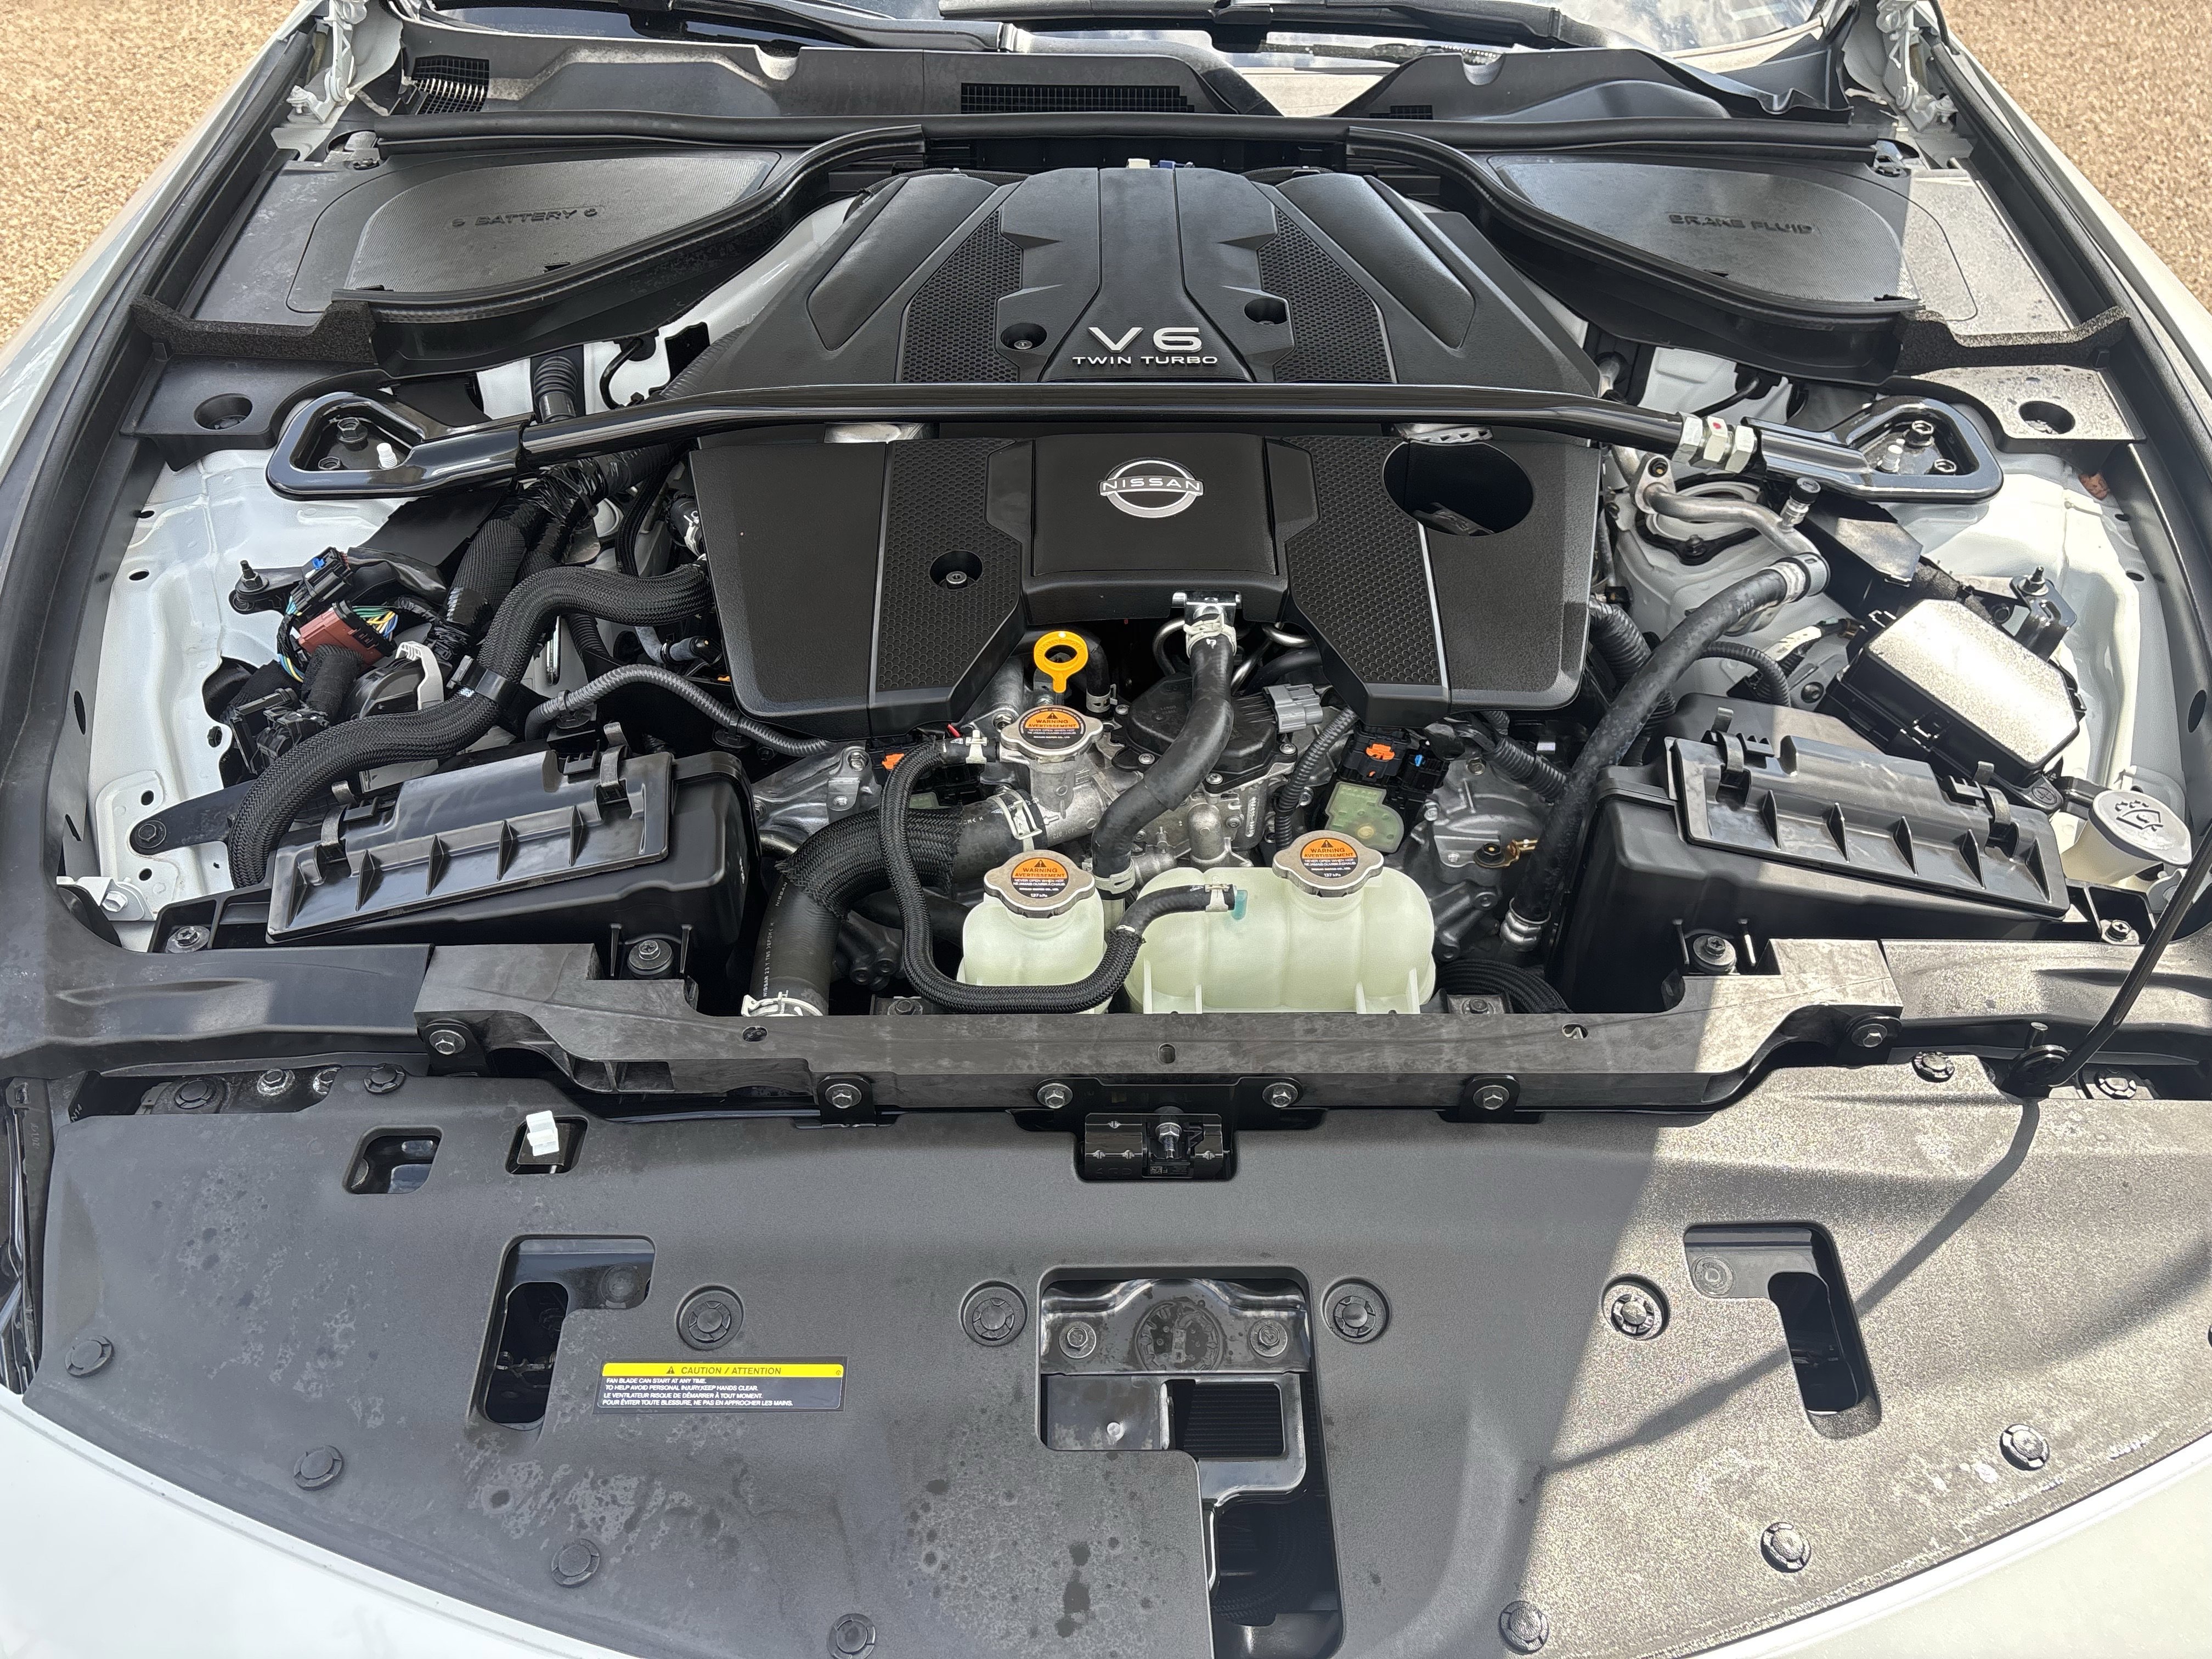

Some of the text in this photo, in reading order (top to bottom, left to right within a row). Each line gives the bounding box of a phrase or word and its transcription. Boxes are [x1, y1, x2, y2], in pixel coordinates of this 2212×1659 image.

[475, 209, 577, 225] BATTERY
[1668, 215, 1813, 234] BRAKE FLUID
[1073, 356, 1218, 366] TWIN TURBO
[1103, 478, 1200, 491] NISSAN
[681, 1366, 781, 1375] CAUTION / ATTENTION
